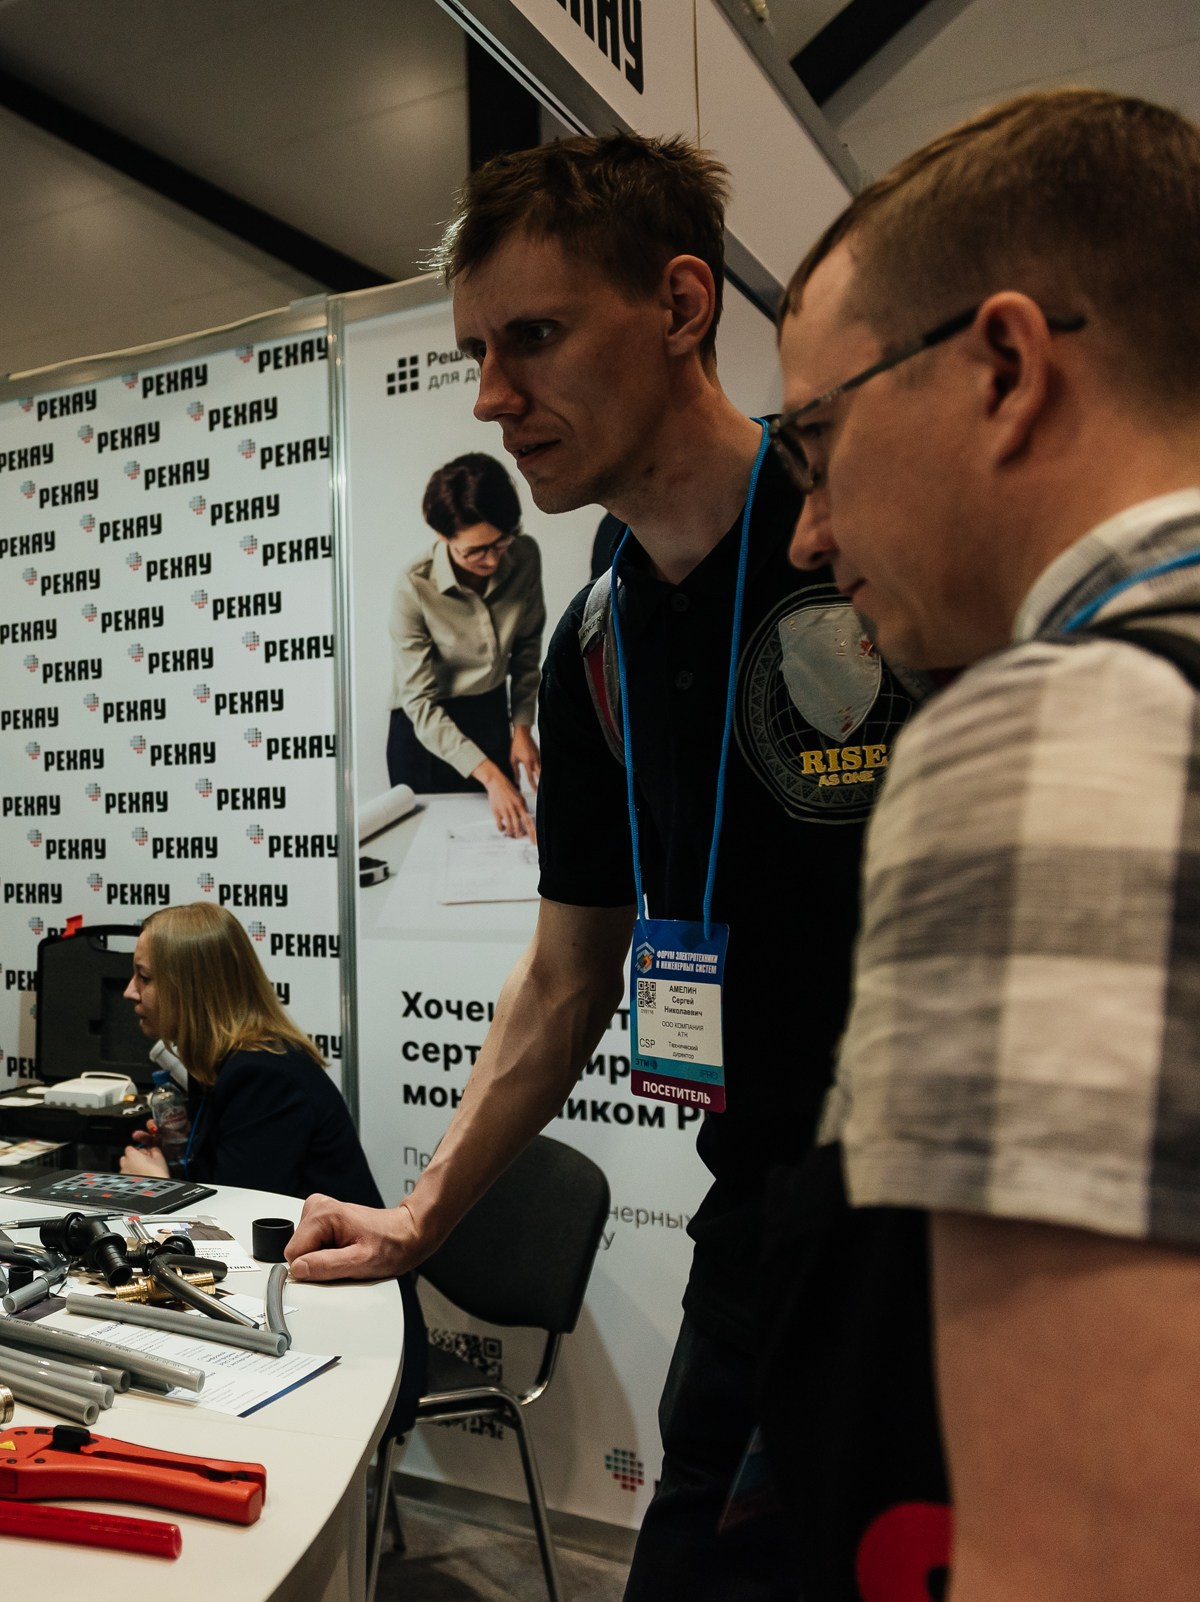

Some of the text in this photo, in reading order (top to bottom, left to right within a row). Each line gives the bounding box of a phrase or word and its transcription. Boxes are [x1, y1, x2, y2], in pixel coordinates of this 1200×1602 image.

[258, 336, 329, 372] РЕХАУ
[142, 364, 208, 398] РЕХАУ
[428, 373, 460, 390] для
[38, 389, 97, 421] РЕХАУ
[209, 397, 277, 431] РЕХАУ
[98, 421, 160, 453] РЕХАУ
[261, 436, 331, 469] РЕХАУ
[145, 458, 209, 490] РЕХАУ
[40, 479, 98, 508] РЕХАУ
[211, 494, 279, 526] РЕХАУ
[100, 514, 161, 543] РЕХАУ
[0, 531, 55, 558] РЕХАУ
[262, 535, 333, 566] РЕХАУ
[147, 553, 211, 582] РЕХАУ
[41, 569, 100, 596] РЕХАУ
[213, 591, 281, 620] РЕХАУ
[0, 619, 56, 644] РЕХАУ
[102, 606, 163, 633] РЕХАУ
[149, 647, 213, 674] РЕХАУ
[265, 635, 335, 663] РЕХАУ
[43, 658, 102, 683] РЕХАУ
[104, 699, 165, 723] РЕХАУ
[215, 686, 283, 715] РЕХАУ
[1, 707, 58, 730] РЕХАУ
[151, 742, 215, 766] РЕХАУ
[267, 734, 337, 760] РЕХАУ
[800, 744, 889, 774] RISE
[45, 749, 104, 771] РЕХАУ
[818, 770, 876, 787] AS ONE
[3, 795, 60, 816] РЕХАУ
[105, 791, 168, 813] РЕХАУ
[217, 787, 285, 810] РЕХАУ
[46, 839, 106, 859] РЕХАУ
[153, 837, 217, 858] РЕХАУ
[269, 835, 338, 858] РЕХАУ
[4, 883, 62, 904] РЕХАУ
[107, 884, 169, 905] РЕХАУ
[219, 884, 287, 907] РЕХАУ
[271, 934, 340, 958] РЕХАУ
[656, 950, 718, 963] ФОРУМ ЭЛЕКТРОТЕХНИКИ
[660, 961, 695, 972] ИНЖЕНЕРНЫХ
[695, 964, 717, 974] СИСТЕМ
[669, 985, 697, 994] АМЕЛИН
[672, 996, 694, 1005] Сергей
[401, 991, 494, 1022] Хоче
[664, 1006, 703, 1016] Николаевич
[674, 1023, 704, 1031] КОМПАНИЯ
[639, 1037, 656, 1049] CSP
[642, 1080, 711, 1104] ПОСЕТИТЕЛЬ
